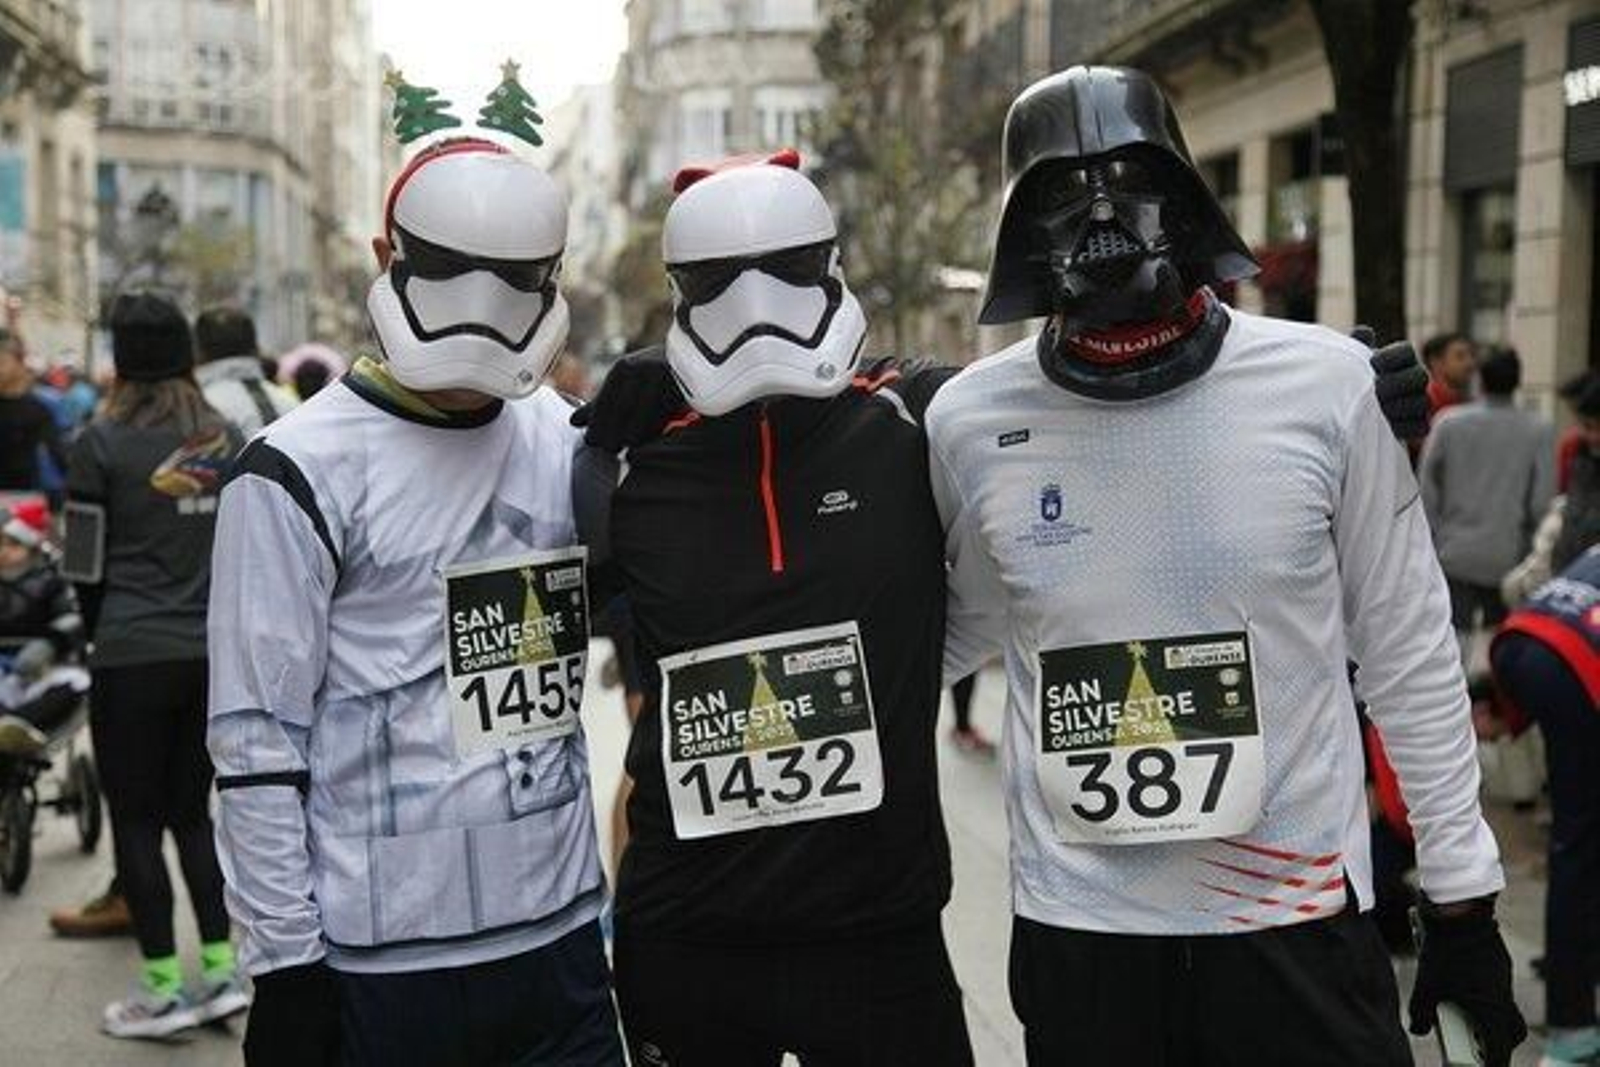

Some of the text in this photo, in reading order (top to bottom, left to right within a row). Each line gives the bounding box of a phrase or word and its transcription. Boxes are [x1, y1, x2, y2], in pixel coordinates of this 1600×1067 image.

[453, 601, 505, 633] SAN
[457, 612, 565, 657] SILVESTRE
[460, 657, 583, 732] 1455
[673, 689, 728, 722] SAN
[1047, 678, 1101, 709] SAN
[1049, 692, 1195, 734] SILVESTRE
[678, 694, 815, 744] SILVESTRE
[679, 738, 861, 816] 1432
[1066, 742, 1234, 822] 387
